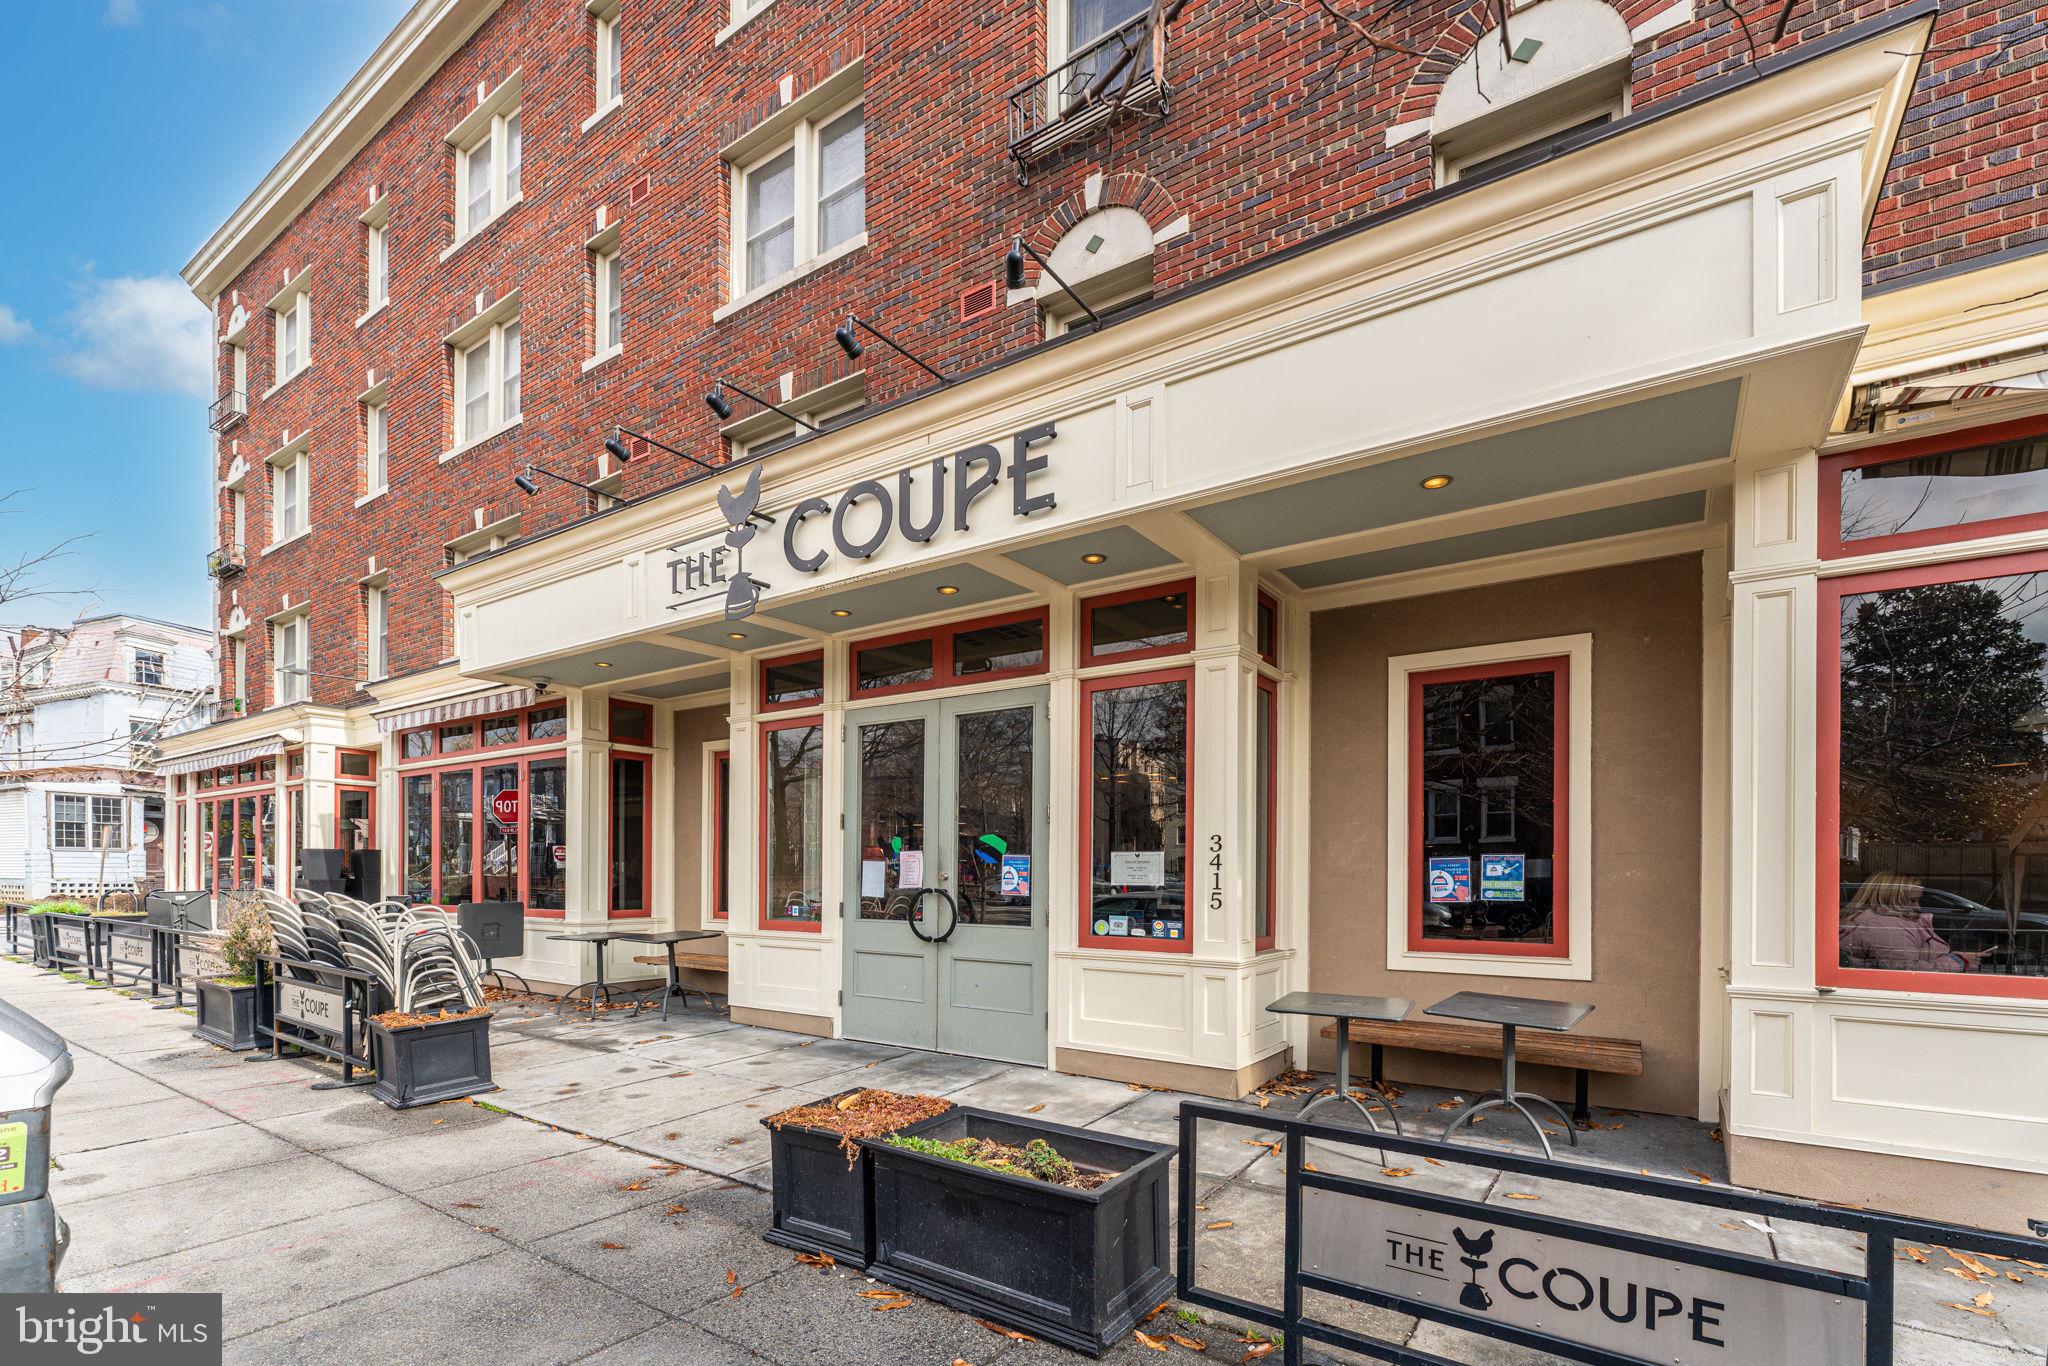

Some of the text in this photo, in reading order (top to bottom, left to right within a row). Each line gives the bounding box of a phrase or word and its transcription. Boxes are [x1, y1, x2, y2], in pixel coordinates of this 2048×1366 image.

[667, 421, 1057, 594] THE COUPE
[1209, 834, 1223, 910] 3415
[304, 998, 329, 1018] COUPE
[1386, 1238, 1726, 1348] THE COUPE
